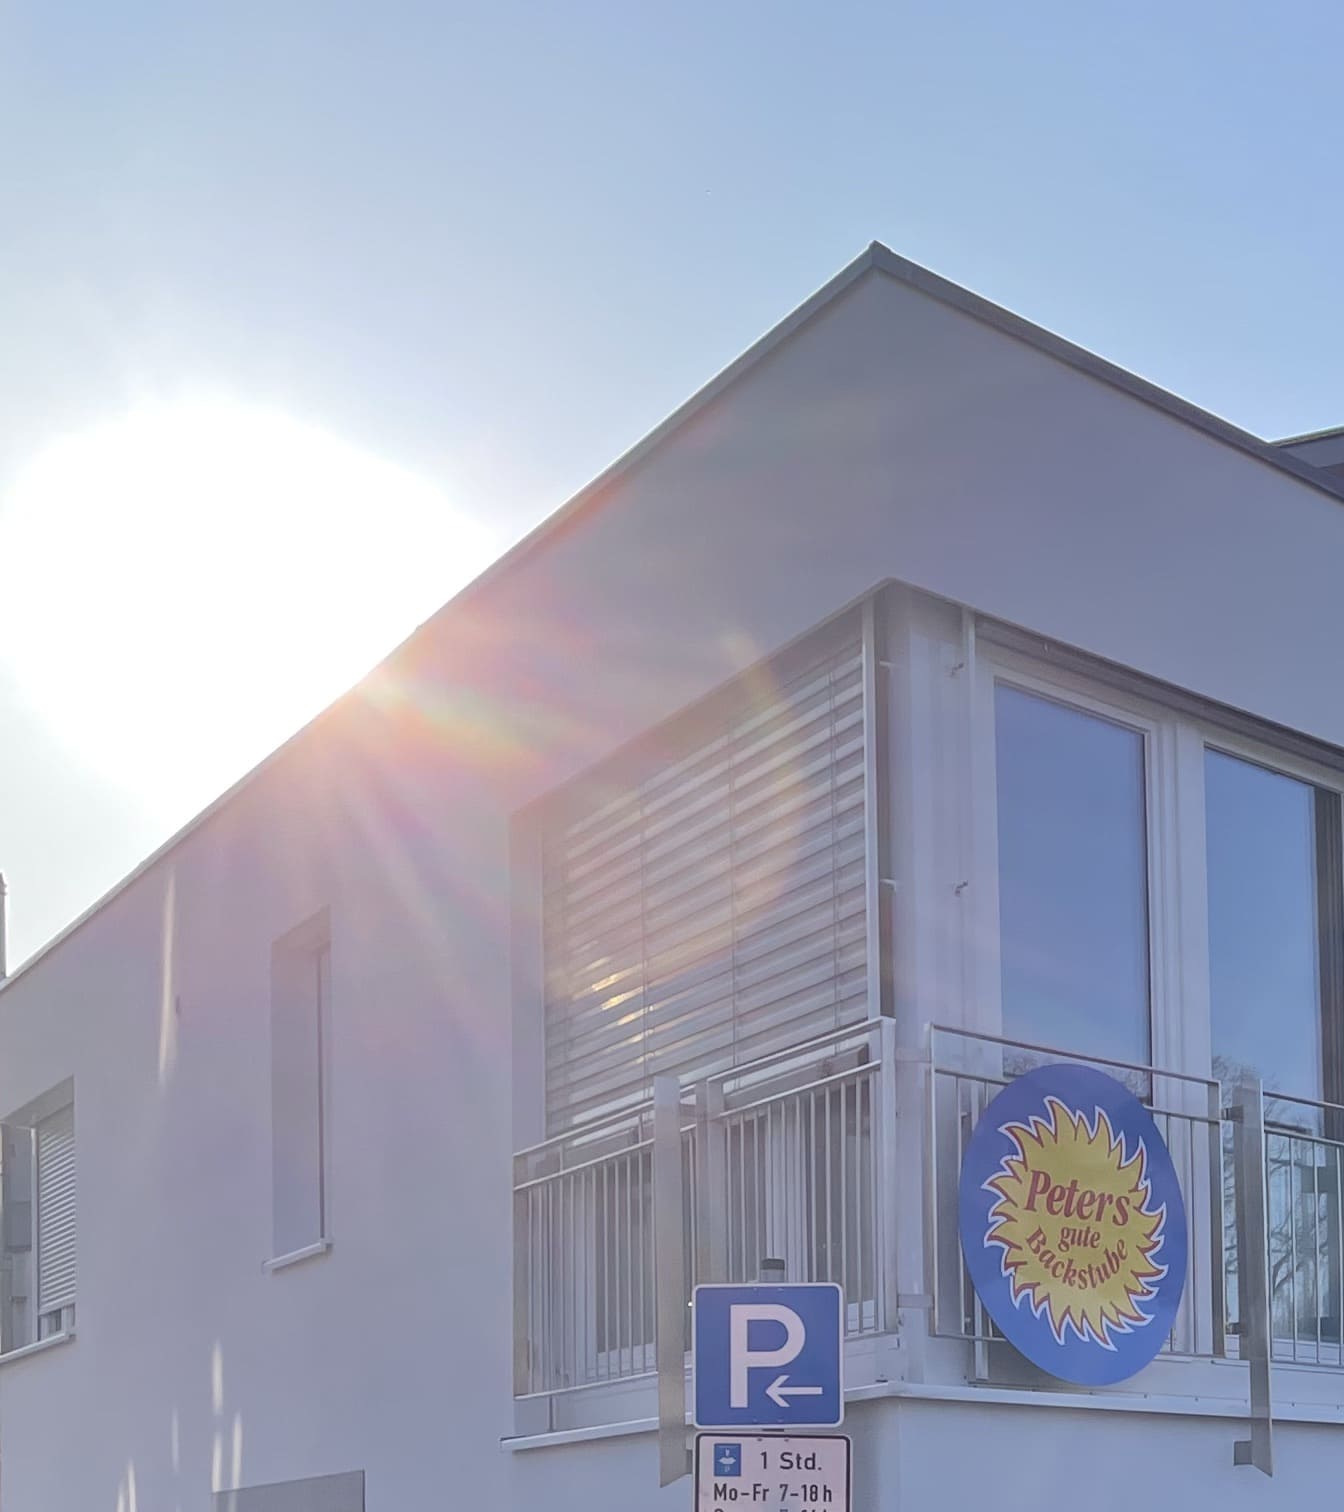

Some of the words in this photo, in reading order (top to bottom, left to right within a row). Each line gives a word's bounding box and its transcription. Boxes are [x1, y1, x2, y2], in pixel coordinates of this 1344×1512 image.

[1024, 1170, 1130, 1226] Peters
[1026, 1226, 1128, 1289] Backstube
[1058, 1226, 1100, 1252] gute
[730, 1303, 806, 1409] P
[760, 1451, 768, 1470] 1
[780, 1451, 822, 1471] Std.
